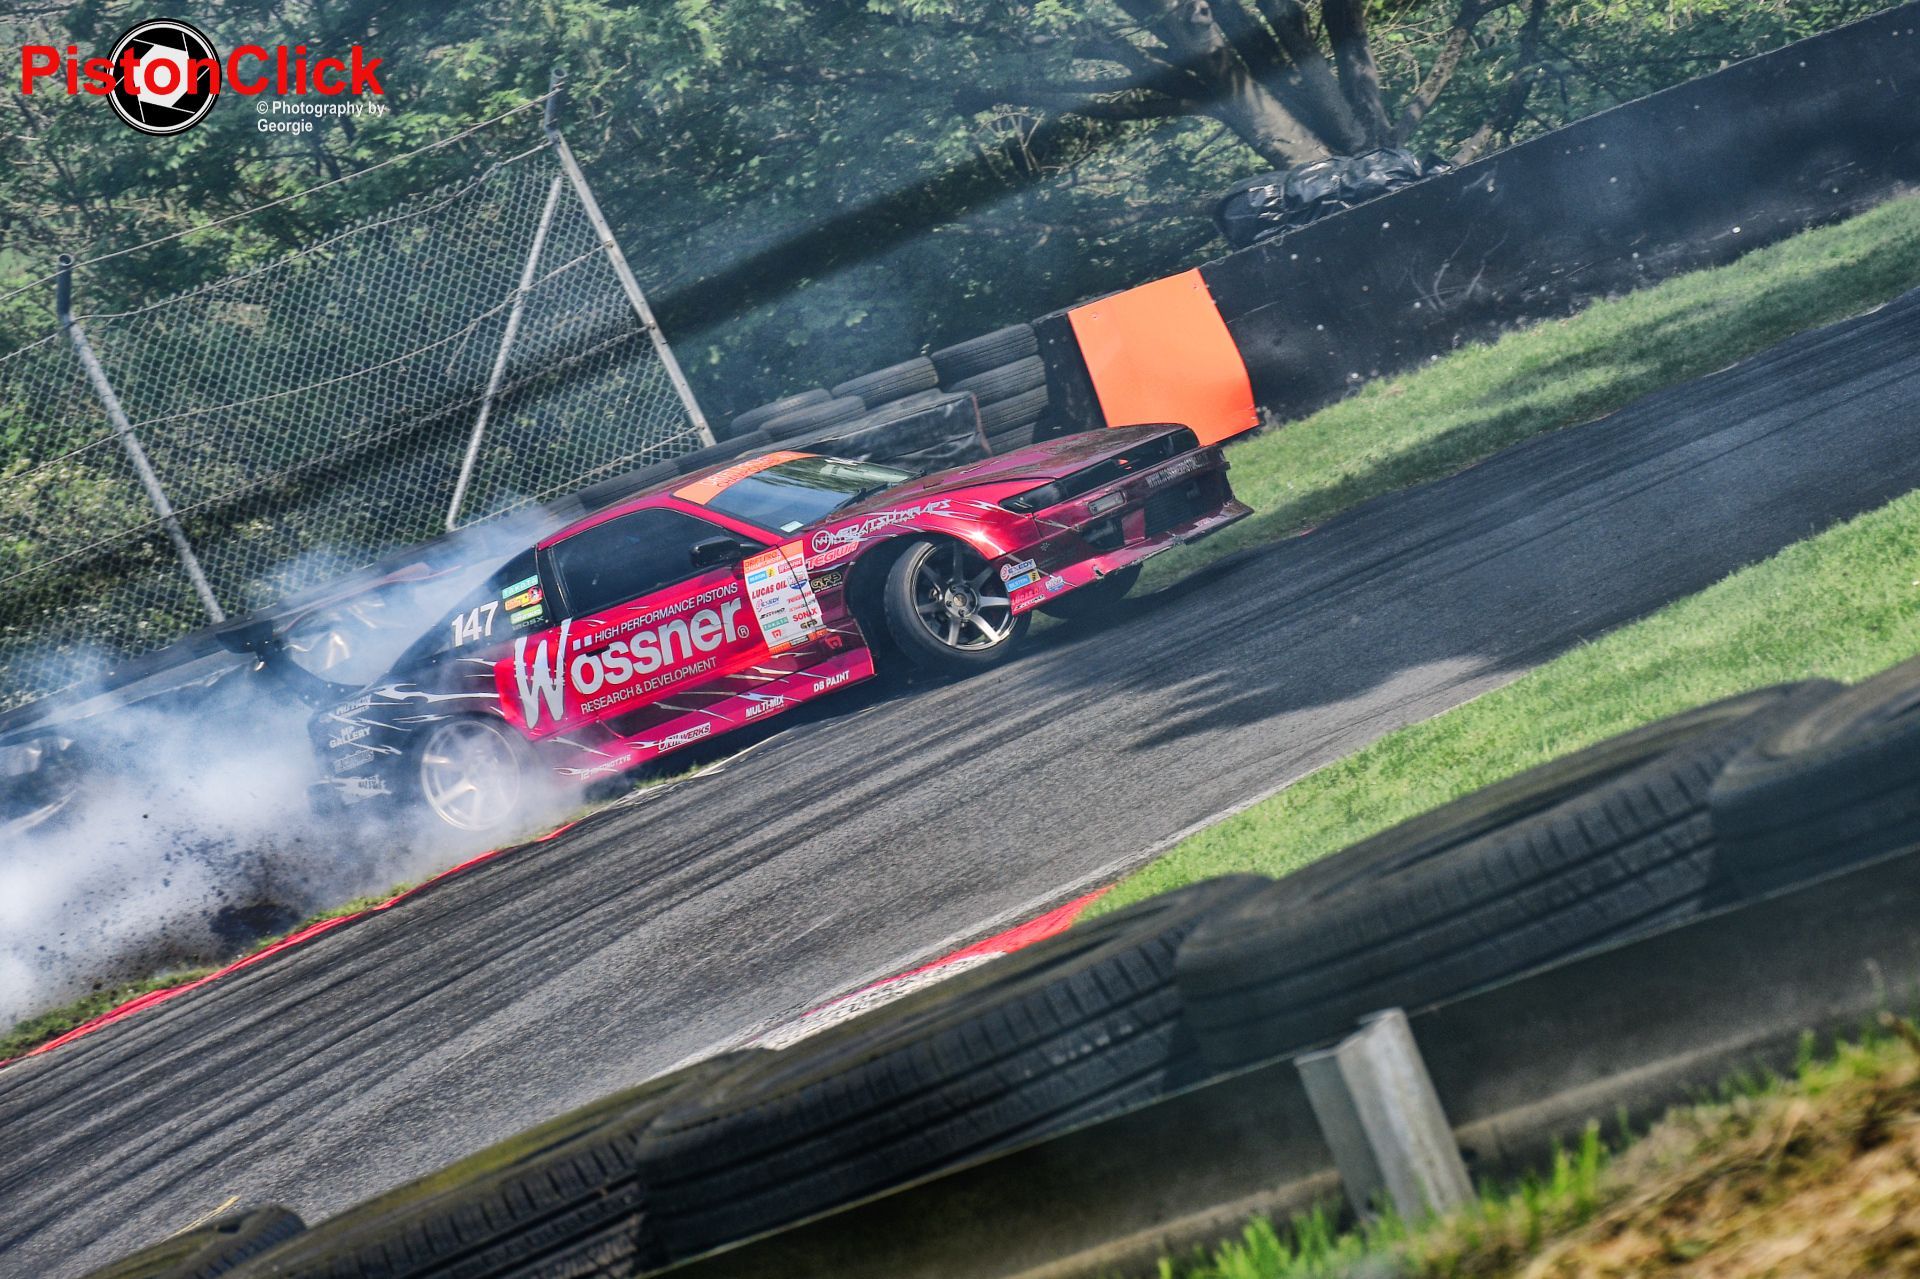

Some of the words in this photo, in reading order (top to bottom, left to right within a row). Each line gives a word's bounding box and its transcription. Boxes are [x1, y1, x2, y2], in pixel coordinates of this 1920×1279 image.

[752, 585, 774, 599] LUCAS
[776, 579, 788, 592] OIL
[594, 621, 620, 642] HIGH
[620, 599, 695, 635] PERFORMANCE
[696, 582, 739, 610] PISTONS
[451, 601, 499, 647] 147
[581, 686, 635, 715] RESEARCH
[635, 684, 644, 695] &
[644, 656, 717, 690] DEVELOPMENT
[813, 680, 825, 693] DB
[826, 670, 850, 688] PAINT
[745, 695, 784, 718] MULTI-MIX
[329, 726, 371, 748] GALLERY
